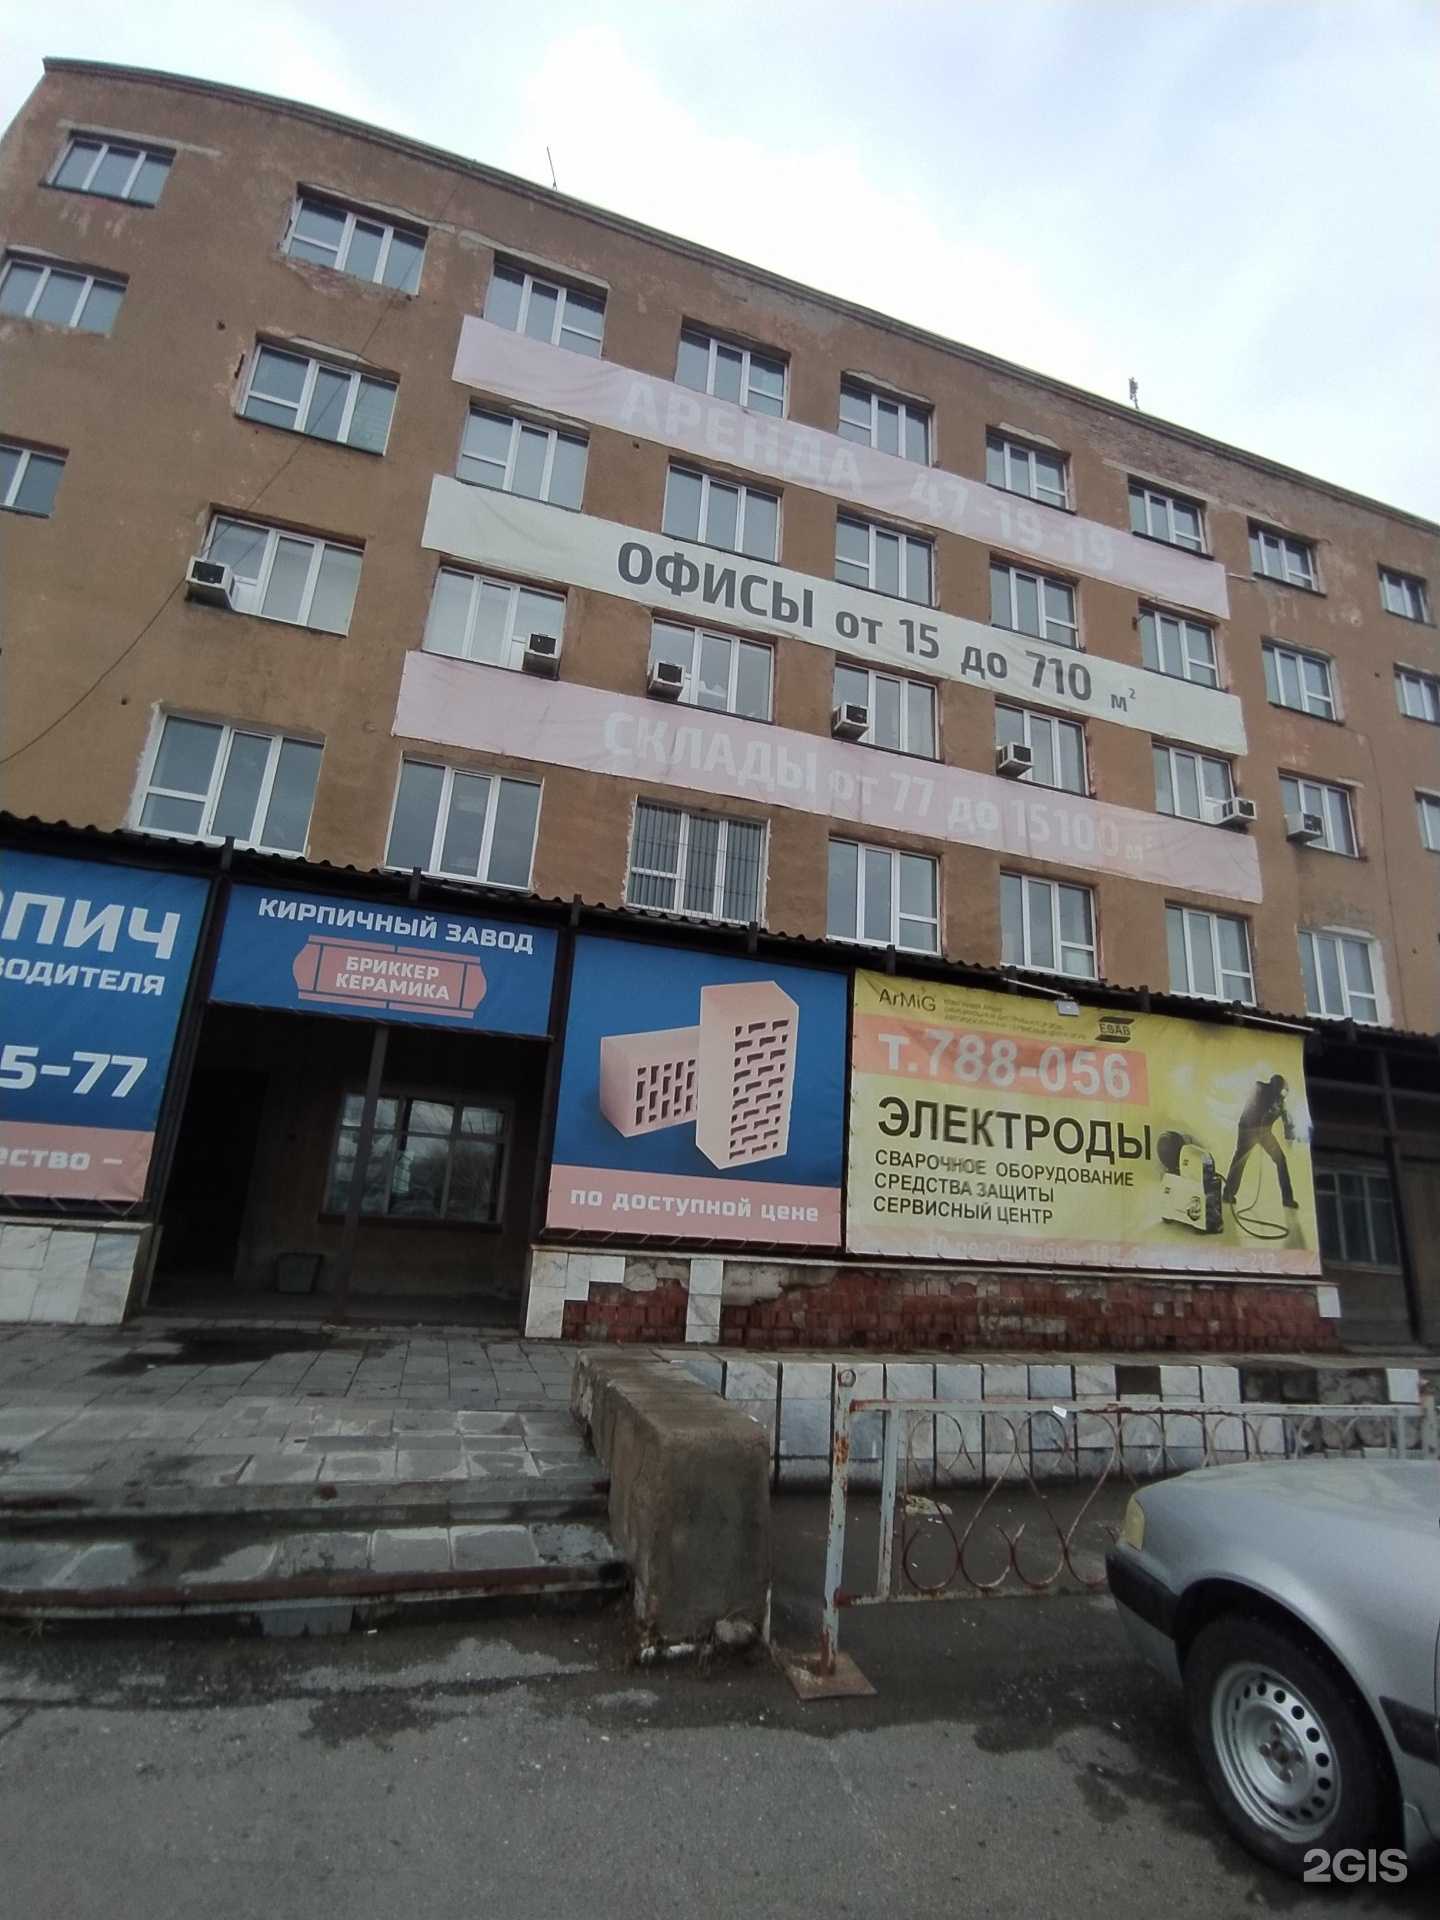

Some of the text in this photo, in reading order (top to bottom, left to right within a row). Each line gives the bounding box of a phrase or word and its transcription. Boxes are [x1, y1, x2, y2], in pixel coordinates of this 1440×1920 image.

[619, 380, 864, 498] АРЕНДА
[617, 541, 814, 627] ОФИСЫ
[835, 611, 882, 644] от
[900, 618, 940, 659] 15
[961, 645, 1008, 681] до
[1025, 650, 1092, 701] 710
[604, 711, 817, 791] СКЛАДЫ
[829, 770, 880, 802] от
[890, 773, 934, 818] 77
[947, 794, 999, 832] до
[0, 890, 181, 959] ПИЧ
[258, 897, 535, 955] КИРПИЧНЫЙ ЗАВОД
[0, 955, 166, 997] ОДИТЕЛЯ
[335, 972, 451, 1001] КЕРАМИКА
[345, 956, 440, 979] БРИККЕР
[878, 1096, 1152, 1164] ЭЛЕКТРОДЫ
[874, 1172, 1054, 1203] СРЕДСТВА ЗАЩИТЫ
[875, 1149, 1134, 1187] СВАРОЧНОЕ ОБОРУДОВАНИЕ
[570, 1188, 819, 1223] по доступной цене
[873, 1195, 1054, 1225] СЕРВИСНЫЙ ЦЕНТР
